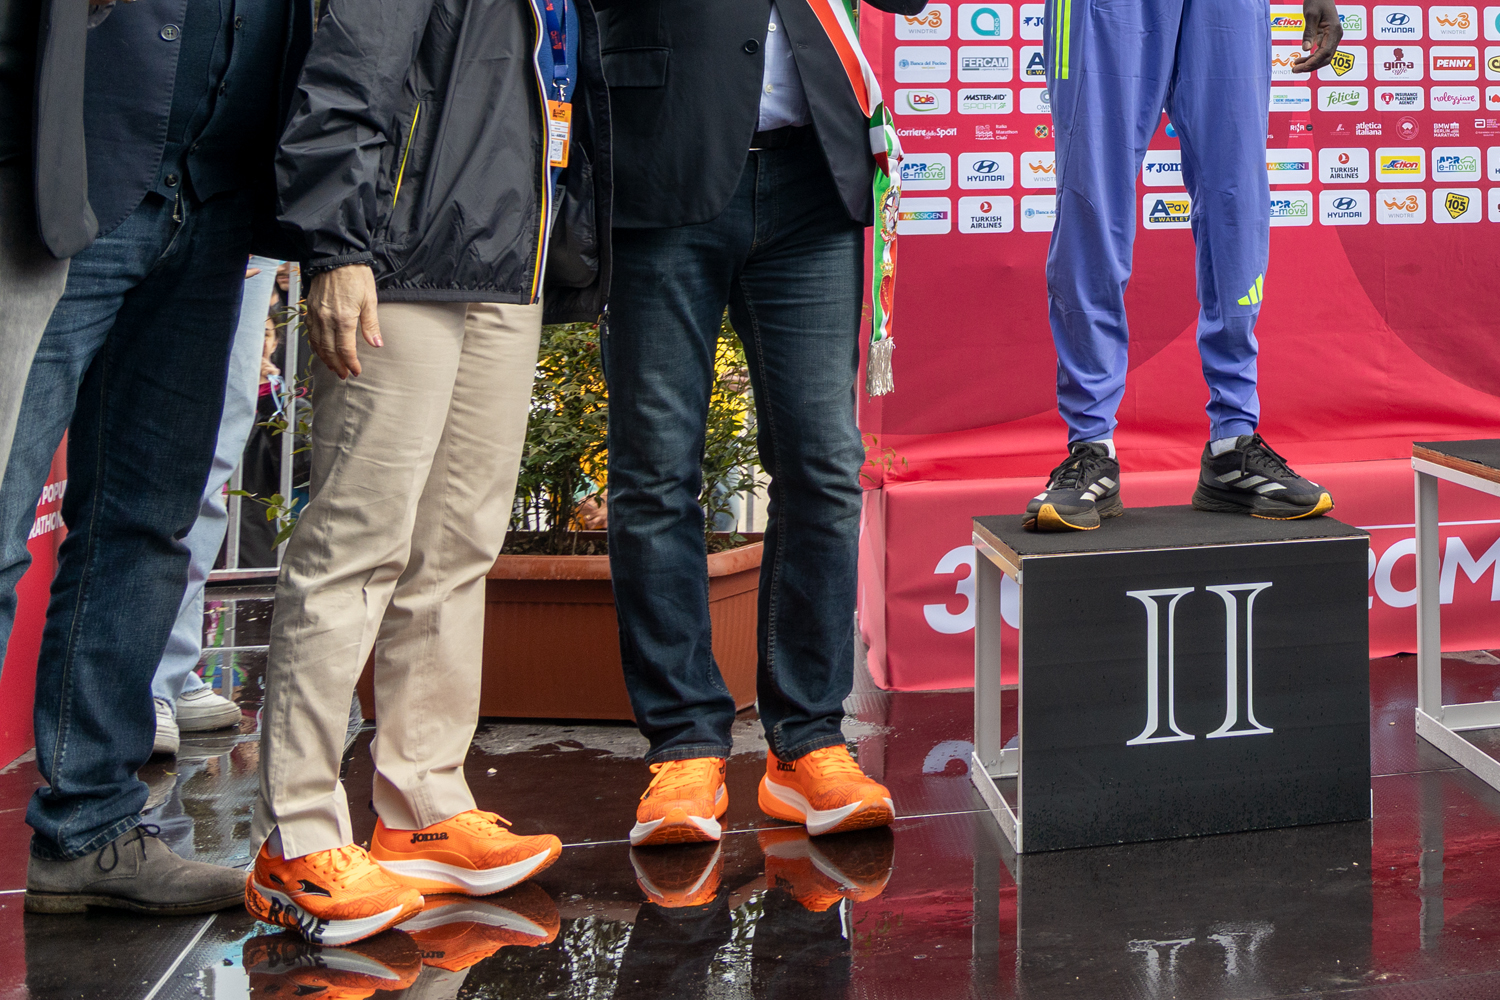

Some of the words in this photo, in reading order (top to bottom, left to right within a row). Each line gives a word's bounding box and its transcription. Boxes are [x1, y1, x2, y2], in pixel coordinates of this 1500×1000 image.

[962, 57, 1009, 68] FERCAM
[1333, 57, 1351, 69] 105
[1384, 61, 1414, 70] gima
[913, 94, 934, 104] Dole
[1326, 90, 1360, 108] felicia
[963, 102, 999, 110] SPORT
[897, 128, 926, 138] Corriere
[936, 127, 957, 138] Sport
[902, 171, 943, 179] e-move
[1448, 199, 1466, 211] 105
[1126, 581, 1274, 747] II
[410, 832, 449, 844] Joma
[268, 896, 330, 944] ROME
